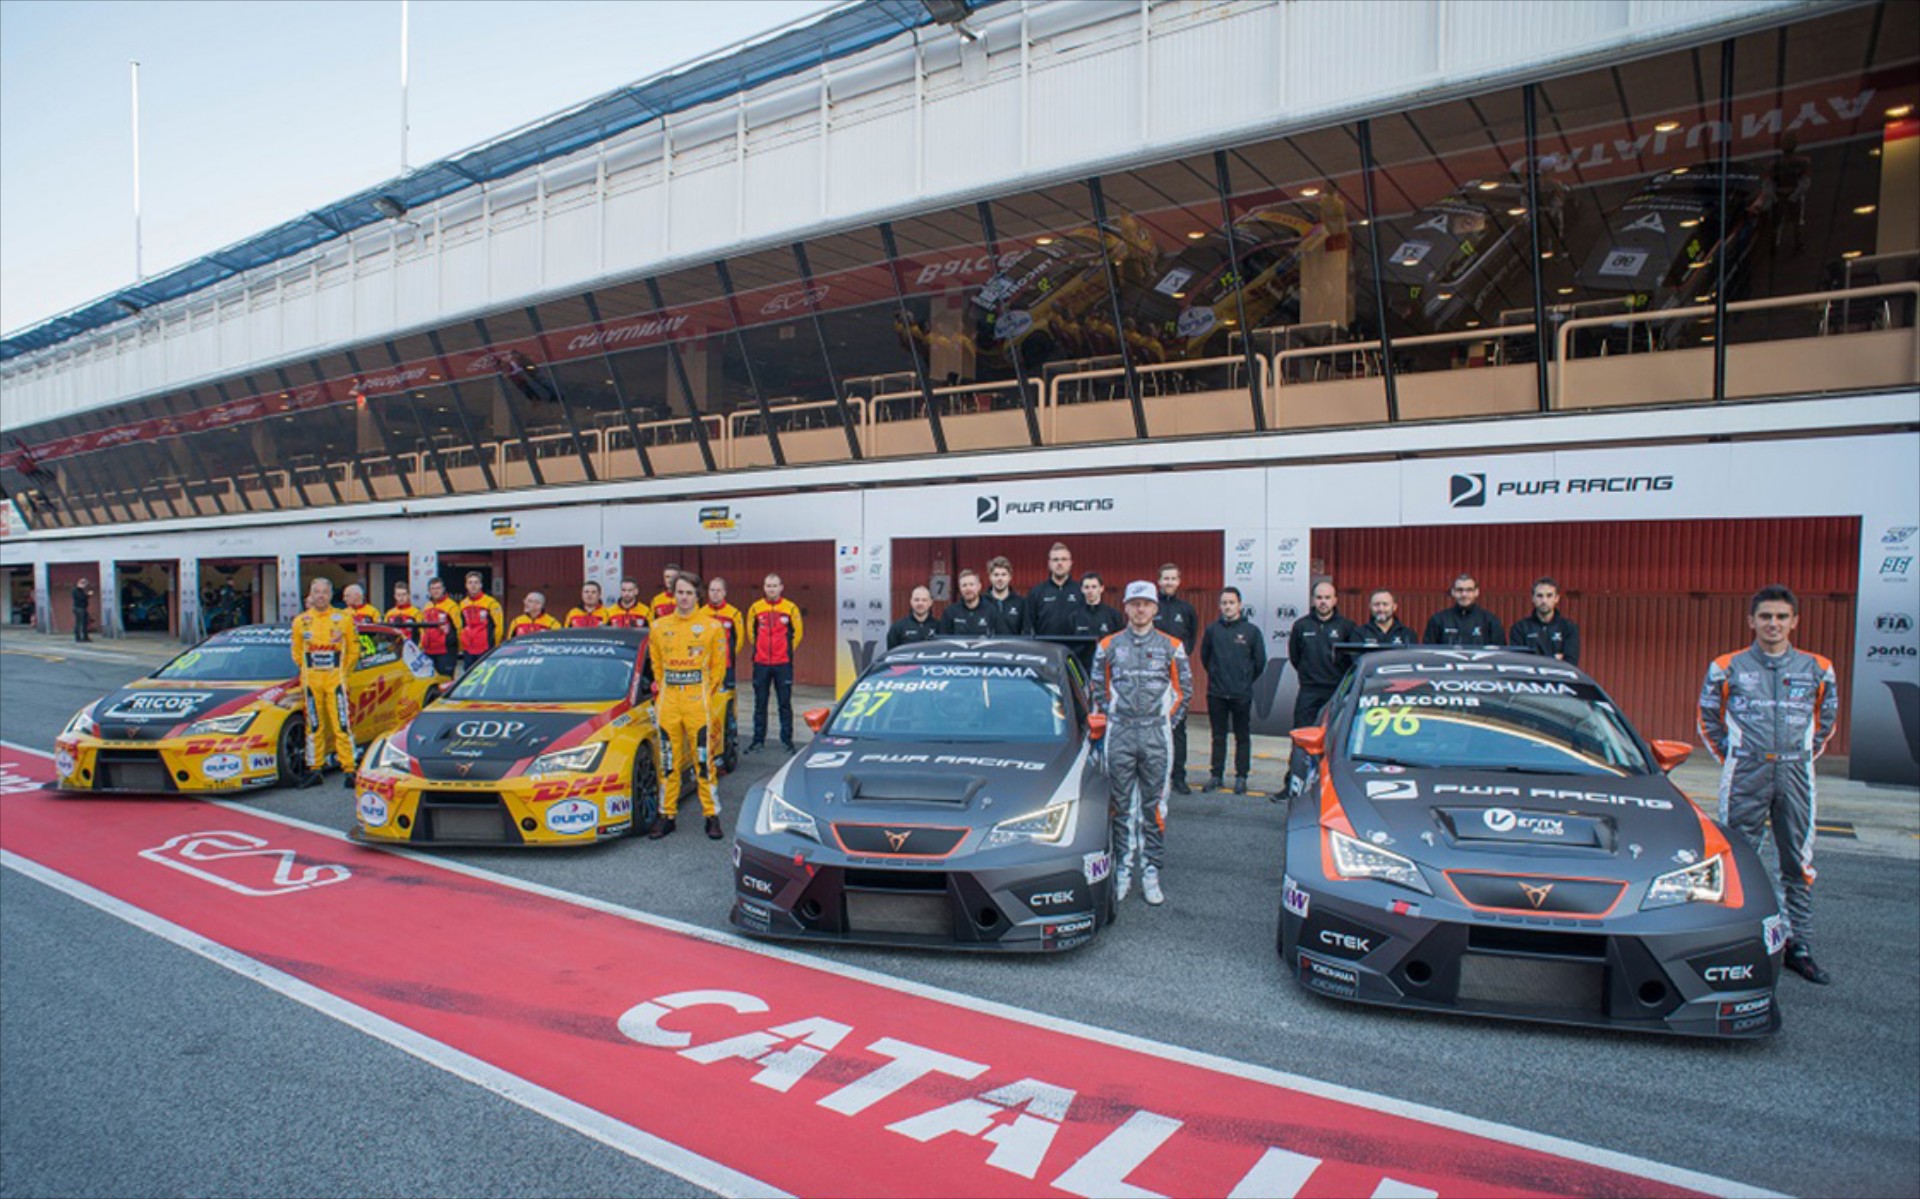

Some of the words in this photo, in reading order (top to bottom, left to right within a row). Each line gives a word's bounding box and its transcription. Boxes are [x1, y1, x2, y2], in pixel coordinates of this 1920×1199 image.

[1497, 479, 1560, 496] PWR
[1566, 475, 1674, 493] RACING
[1005, 501, 1045, 514] PWR
[1048, 498, 1114, 512] RACING
[936, 580, 945, 595] 7
[527, 645, 616, 656] YOKOHAMA
[884, 651, 1048, 665] CUPRA
[461, 666, 497, 687] 21
[921, 665, 1039, 678] YOKOHAMA
[1376, 663, 1579, 680] CUPRA
[856, 679, 950, 691] D.Haglöf
[1429, 680, 1577, 695] YOKOHAMA
[843, 691, 893, 719] 37
[1359, 694, 1481, 708] M.Azcona
[456, 720, 525, 738] GDP
[1364, 707, 1421, 736] 96
[185, 735, 269, 755] DHL
[253, 756, 274, 768] KW
[859, 754, 930, 763] PWR
[934, 755, 1047, 771] RACING
[531, 775, 625, 802] DHL
[1433, 783, 1520, 796] PWR
[1529, 788, 1674, 810] RACING
[611, 799, 631, 814] KW
[551, 809, 594, 824] eurol
[742, 874, 773, 894] CTEK
[1030, 890, 1074, 906] CTEK
[1320, 930, 1370, 952] CTEK
[1311, 961, 1355, 982] YOKOHAMA
[1704, 964, 1754, 981] CTEK
